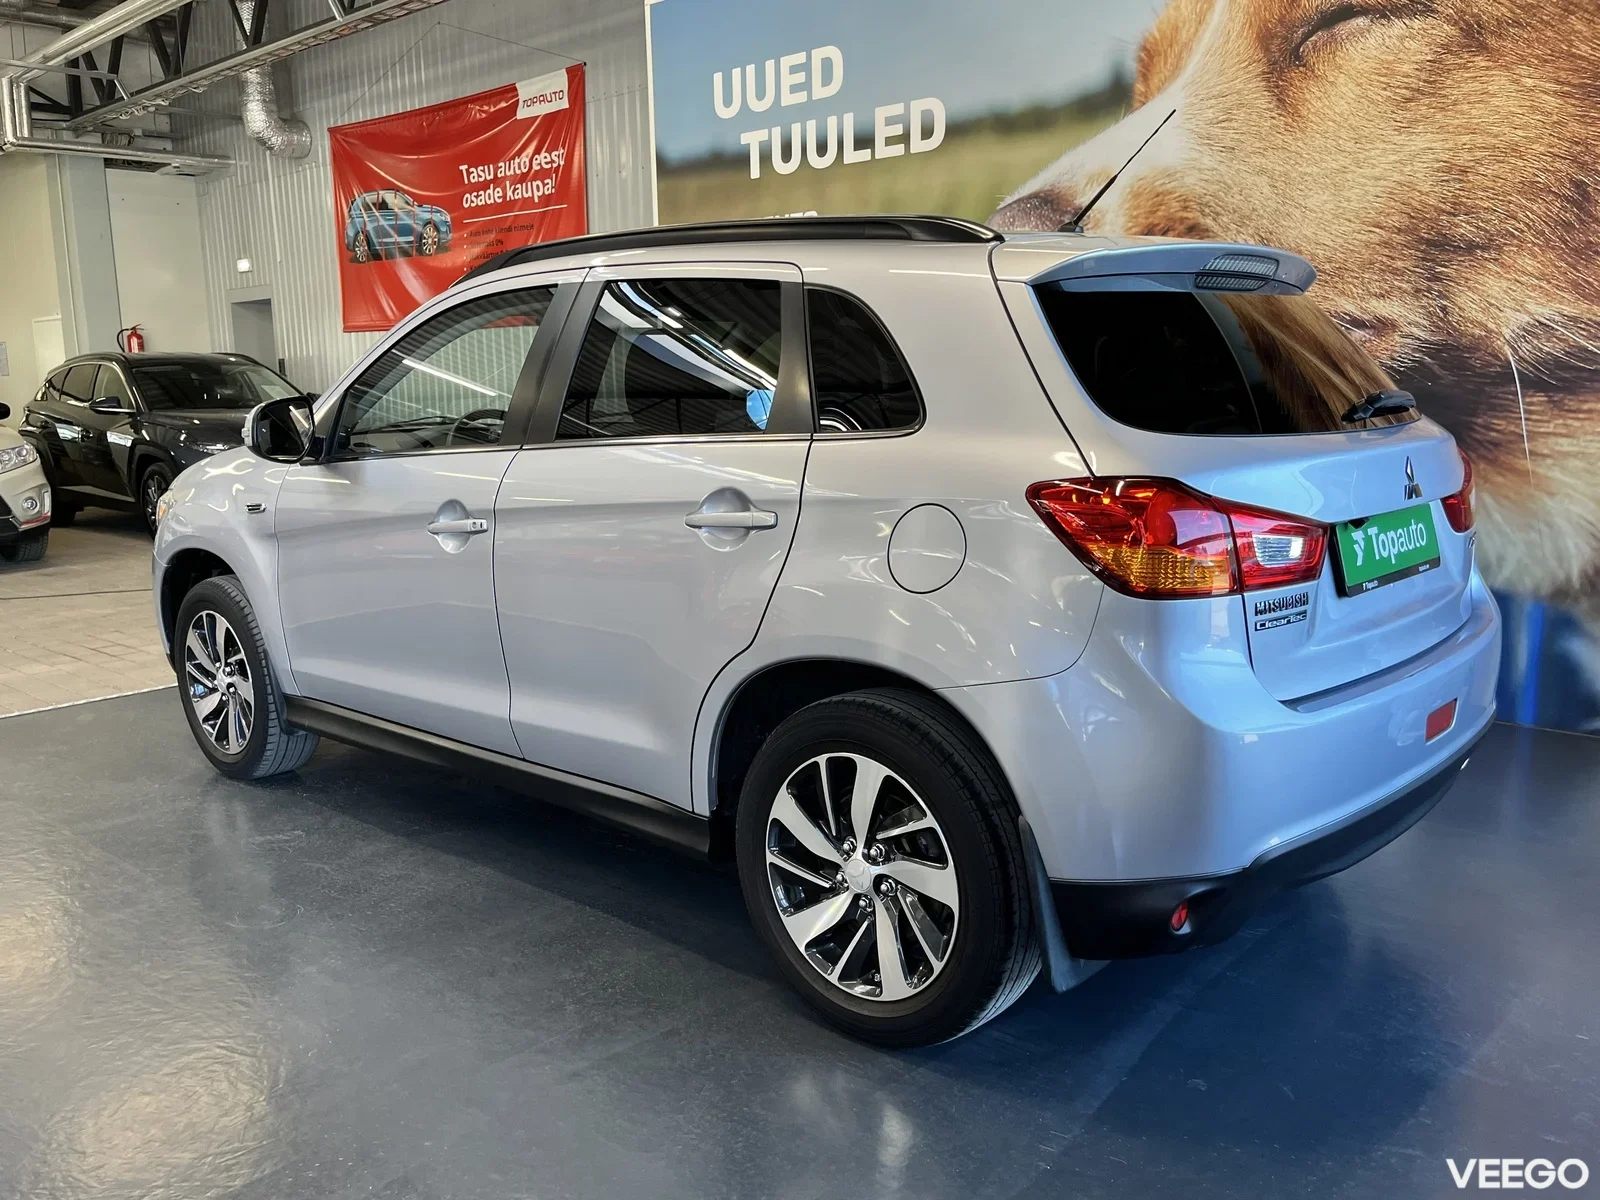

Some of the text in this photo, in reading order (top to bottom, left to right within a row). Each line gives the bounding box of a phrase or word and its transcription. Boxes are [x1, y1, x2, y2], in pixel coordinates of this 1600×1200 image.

[522, 90, 564, 109] TOPAUTO
[713, 45, 844, 119] UUED
[740, 97, 946, 180] TUULED
[459, 146, 565, 185] Tasu auto eest
[462, 173, 556, 208] osade kaupa!
[1367, 519, 1427, 565] Topauto
[1256, 613, 1307, 630] ClearTec
